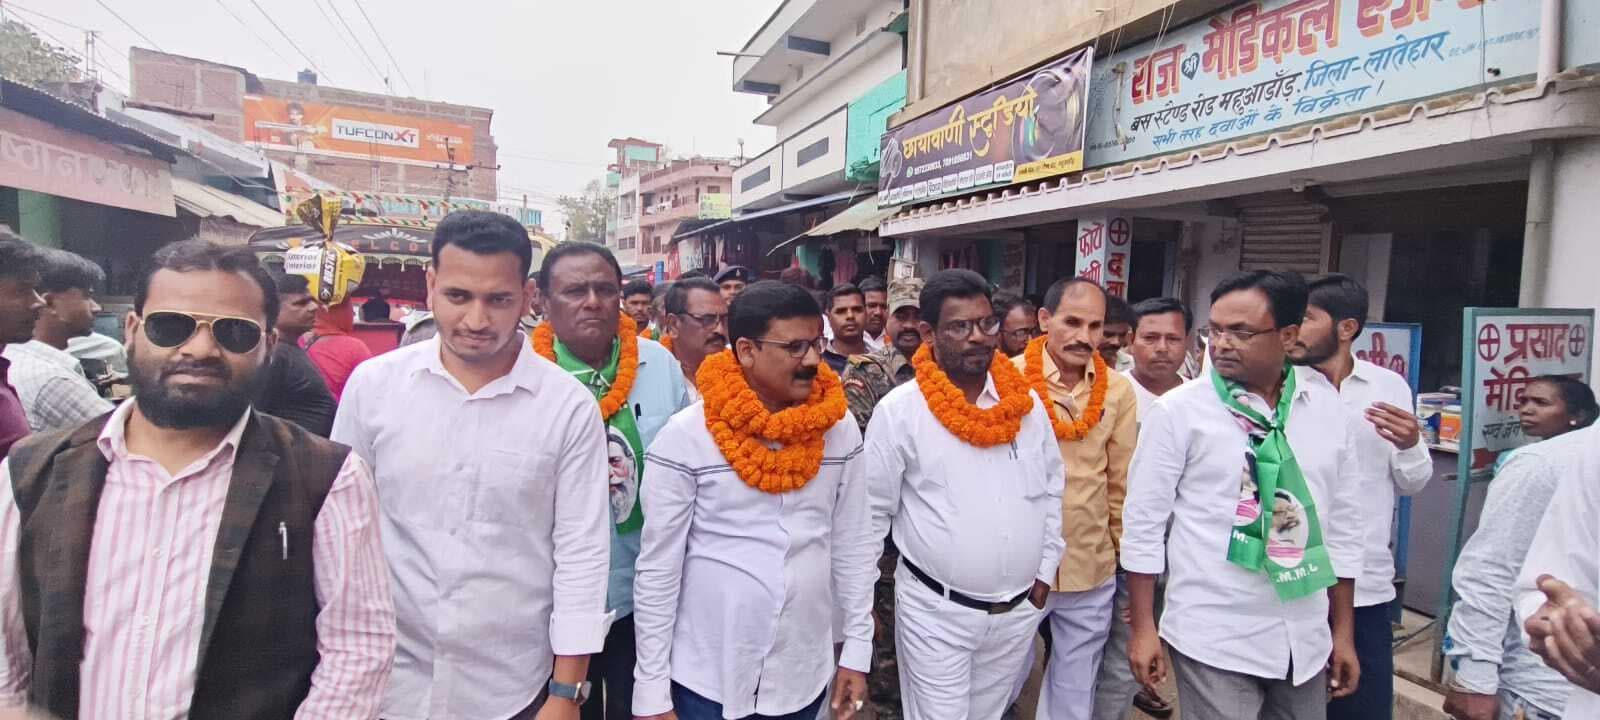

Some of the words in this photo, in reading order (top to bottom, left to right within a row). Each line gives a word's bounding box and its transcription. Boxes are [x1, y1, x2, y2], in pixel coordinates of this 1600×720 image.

[1131, 44, 1187, 104] राज
[1184, 53, 1199, 75] श्री
[1202, 0, 1341, 80] मेडिकल
[902, 104, 966, 160] छायावाणी
[1131, 112, 1153, 132] बस
[1192, 93, 1220, 122] रोड
[1153, 129, 1177, 147] सभी
[1179, 125, 1204, 143] तरह
[1209, 110, 1260, 137] दवाओं
[1264, 104, 1283, 124] के
[1294, 84, 1372, 117] विक्रेता
[1504, 323, 1570, 364] प्रसाद
